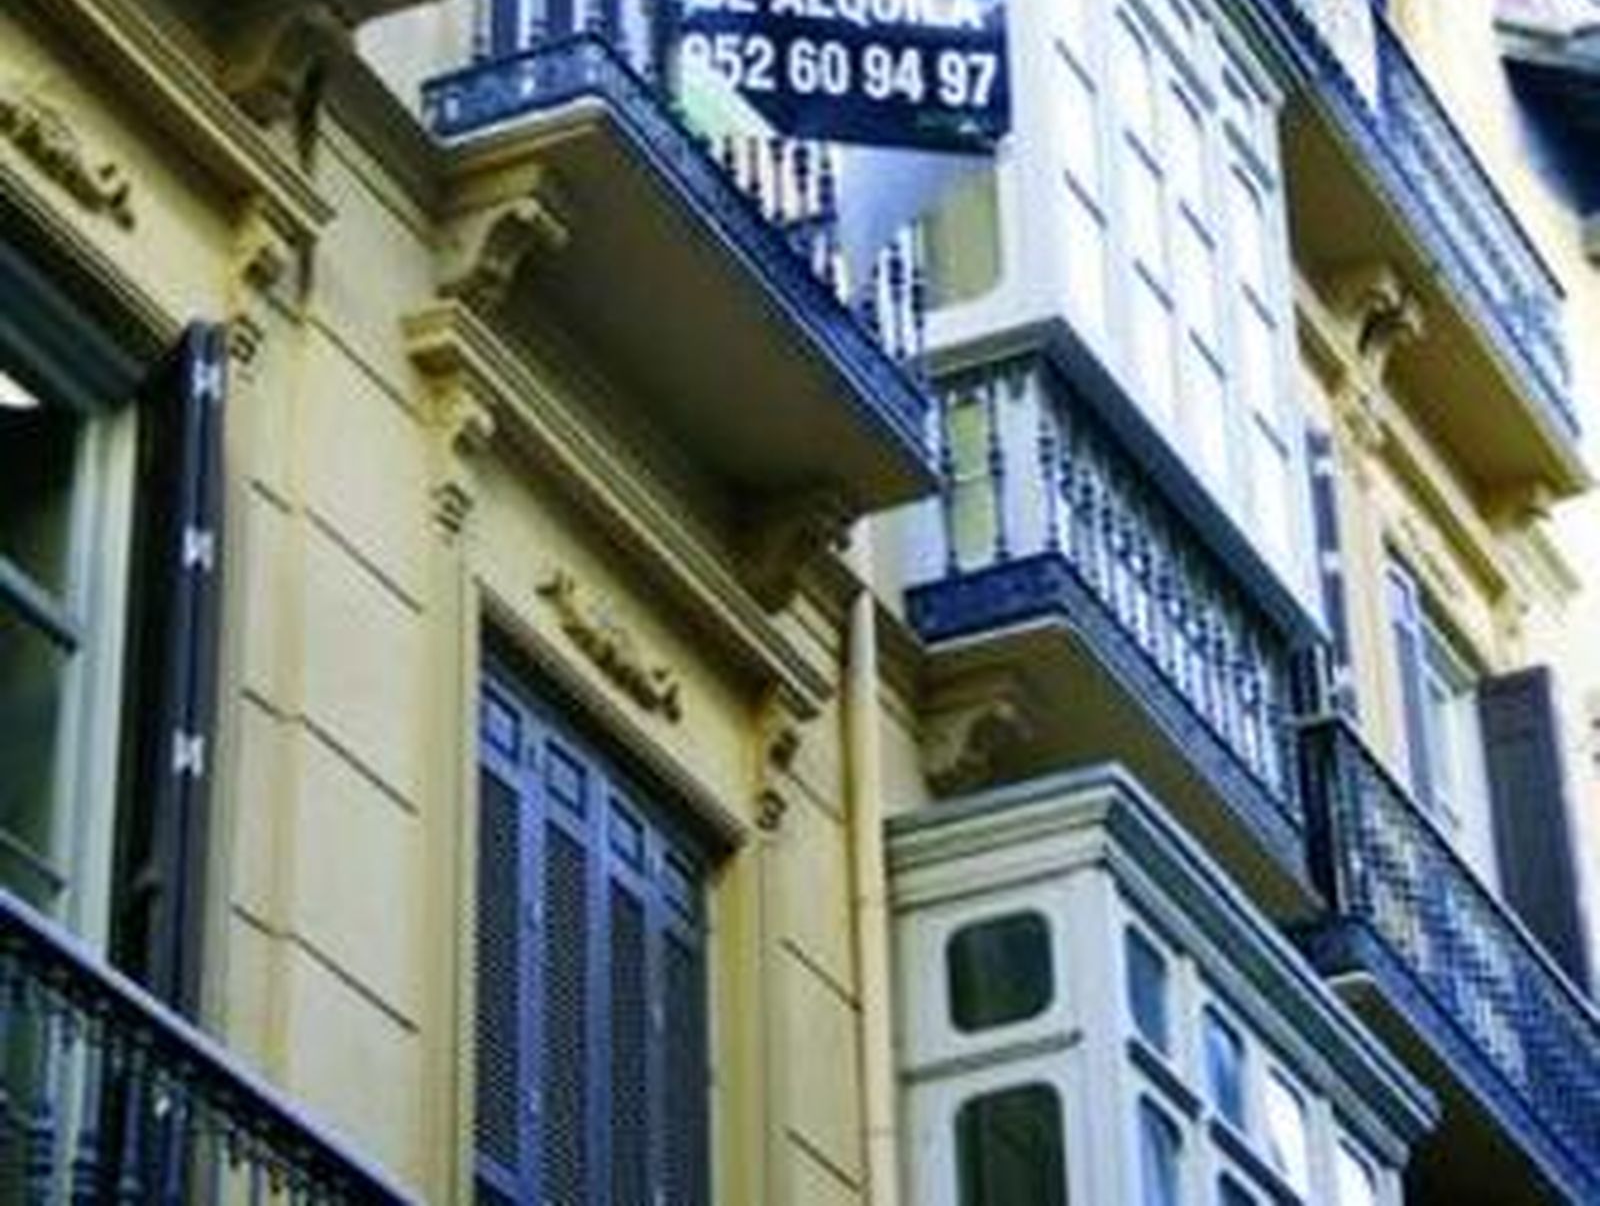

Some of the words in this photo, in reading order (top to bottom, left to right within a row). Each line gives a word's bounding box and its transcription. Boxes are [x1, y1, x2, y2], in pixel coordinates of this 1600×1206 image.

[788, 37, 850, 95] 60
[861, 44, 924, 104] 94
[937, 50, 998, 108] 97
